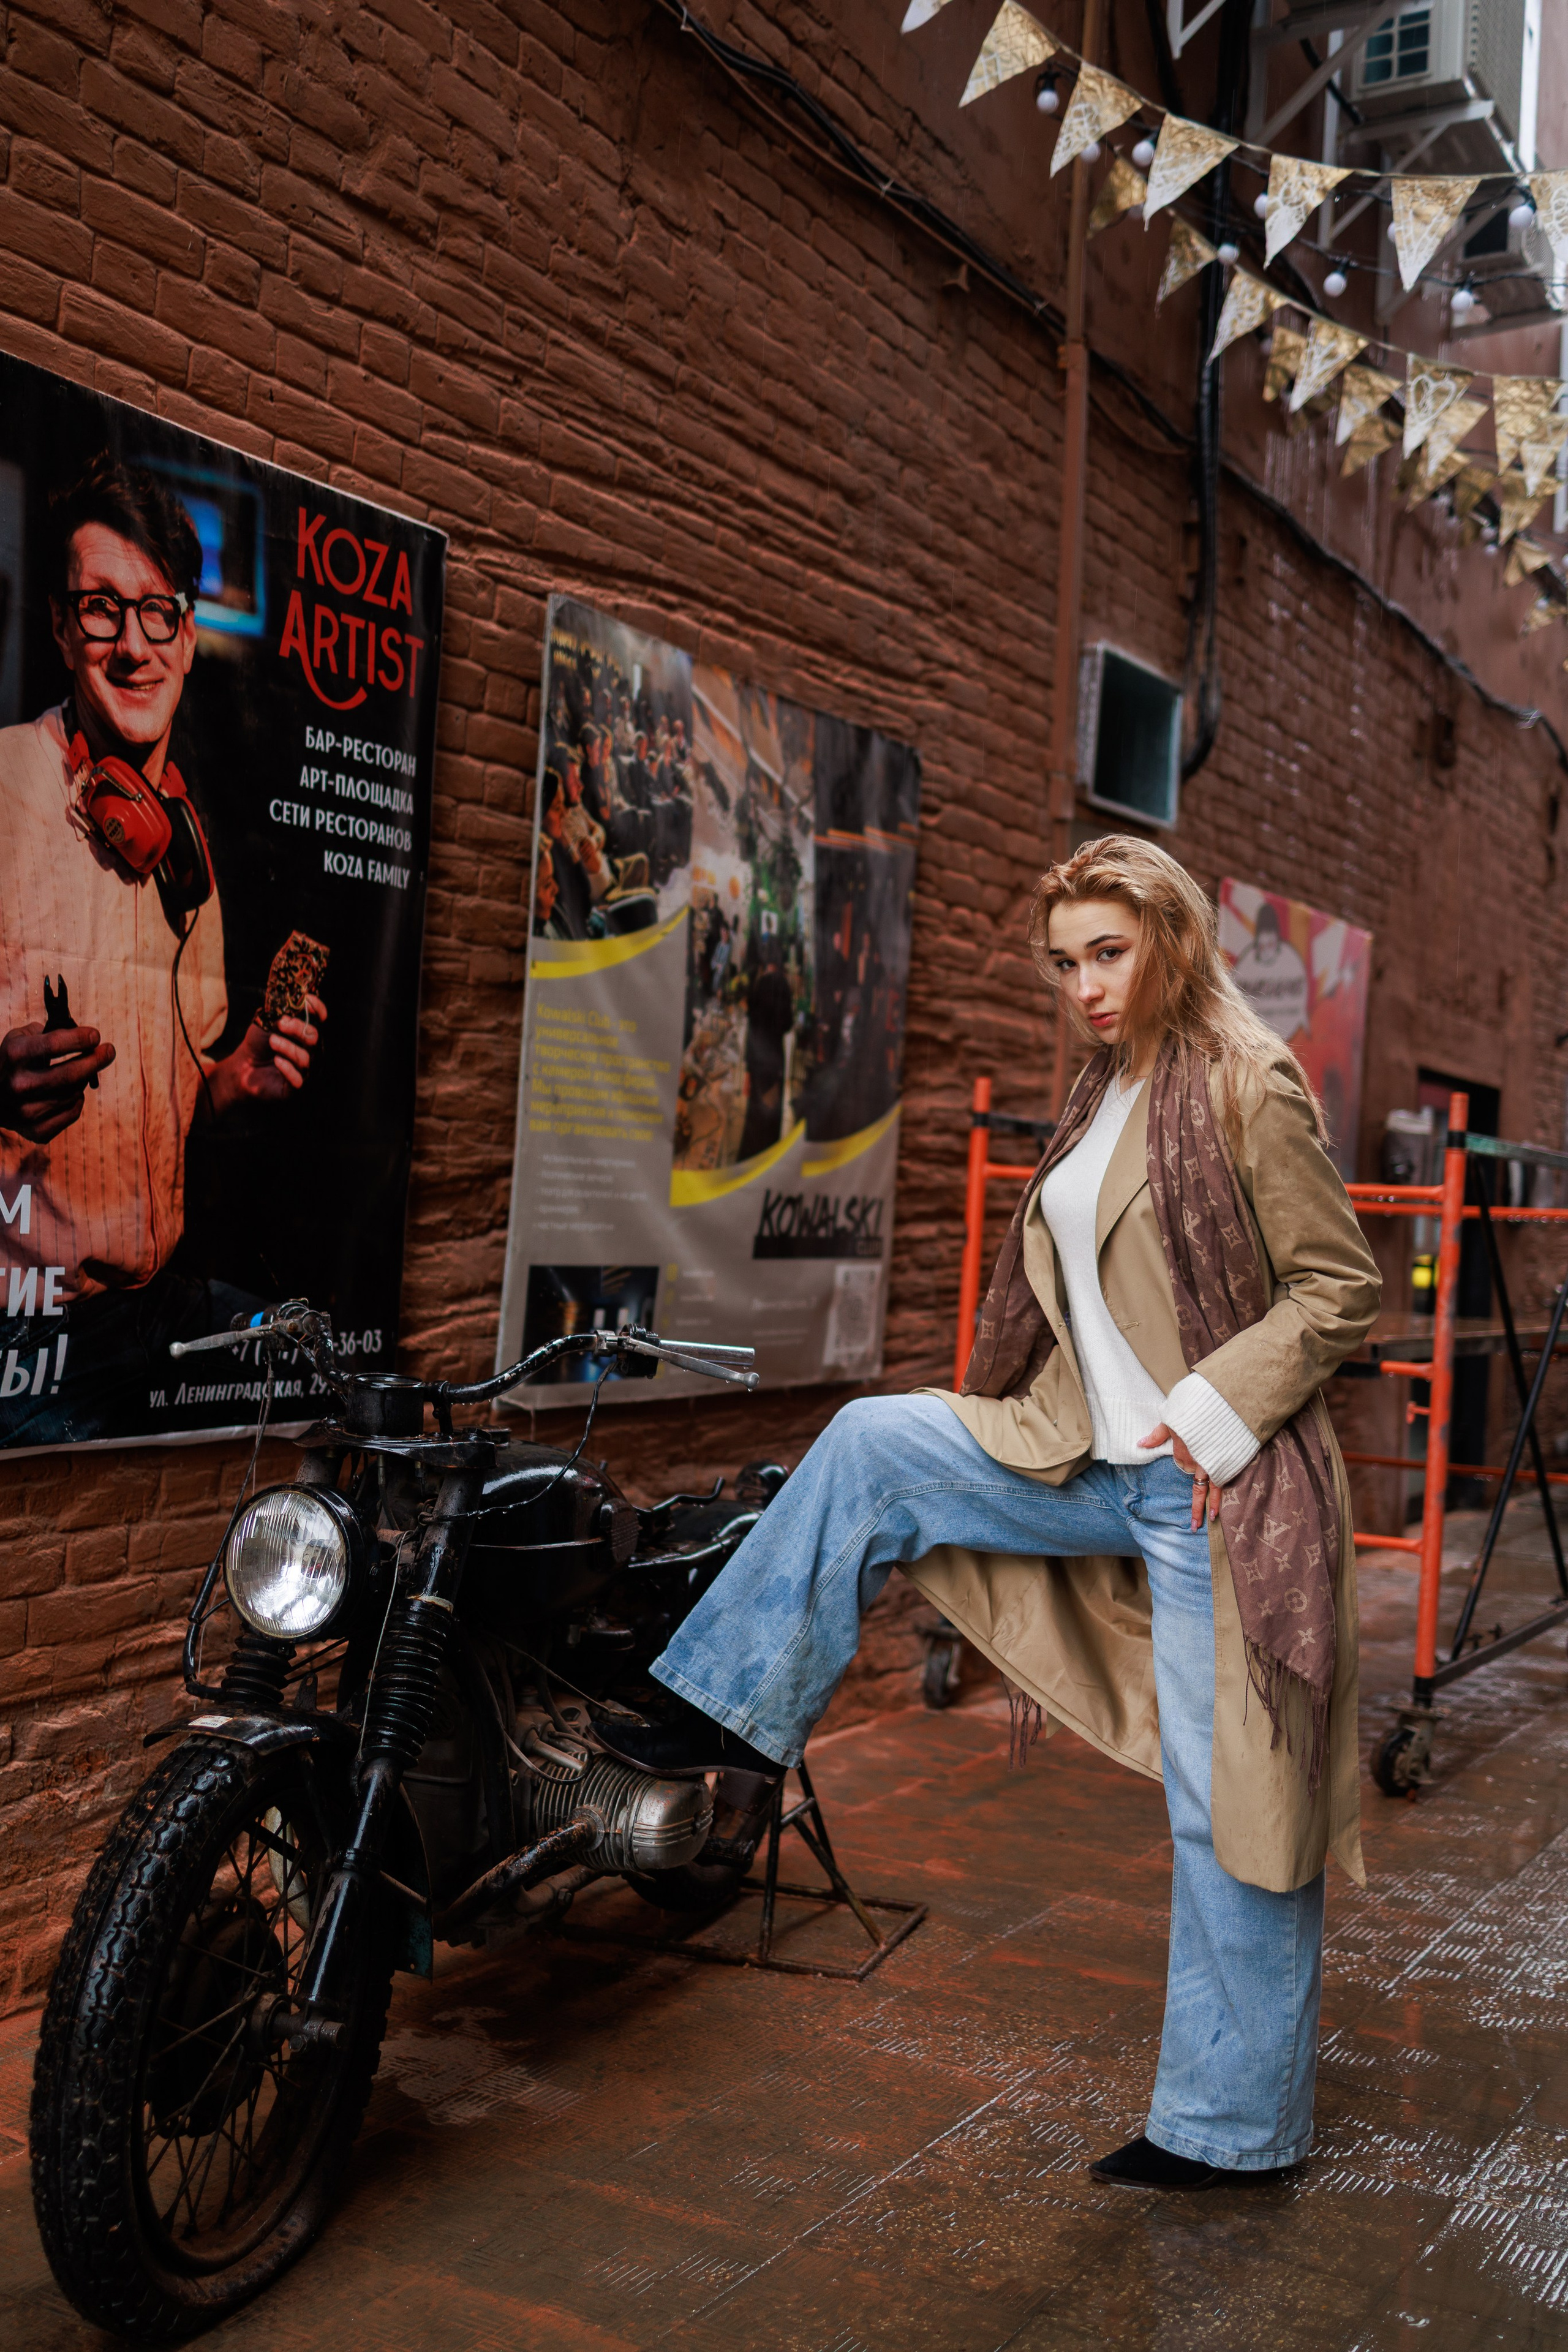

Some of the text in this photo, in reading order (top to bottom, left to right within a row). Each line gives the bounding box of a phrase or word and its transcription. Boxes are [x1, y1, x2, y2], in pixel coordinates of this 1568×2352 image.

[297, 506, 413, 616] KOZA
[279, 589, 424, 710] ARTIST
[305, 725, 417, 777] БАР-РЕСТОРАН
[300, 766, 413, 815] АРТ-ПЛОЩАДКА
[270, 799, 412, 853] СЕТИ РЕСТОРАНОВ
[323, 850, 410, 890] KOZA FAMILY
[758, 1187, 884, 1238] KOWALSKI
[0, 1266, 65, 1317] ИЕ
[0, 1333, 68, 1398] Ы!
[333, 1329, 382, 1356] -36-03
